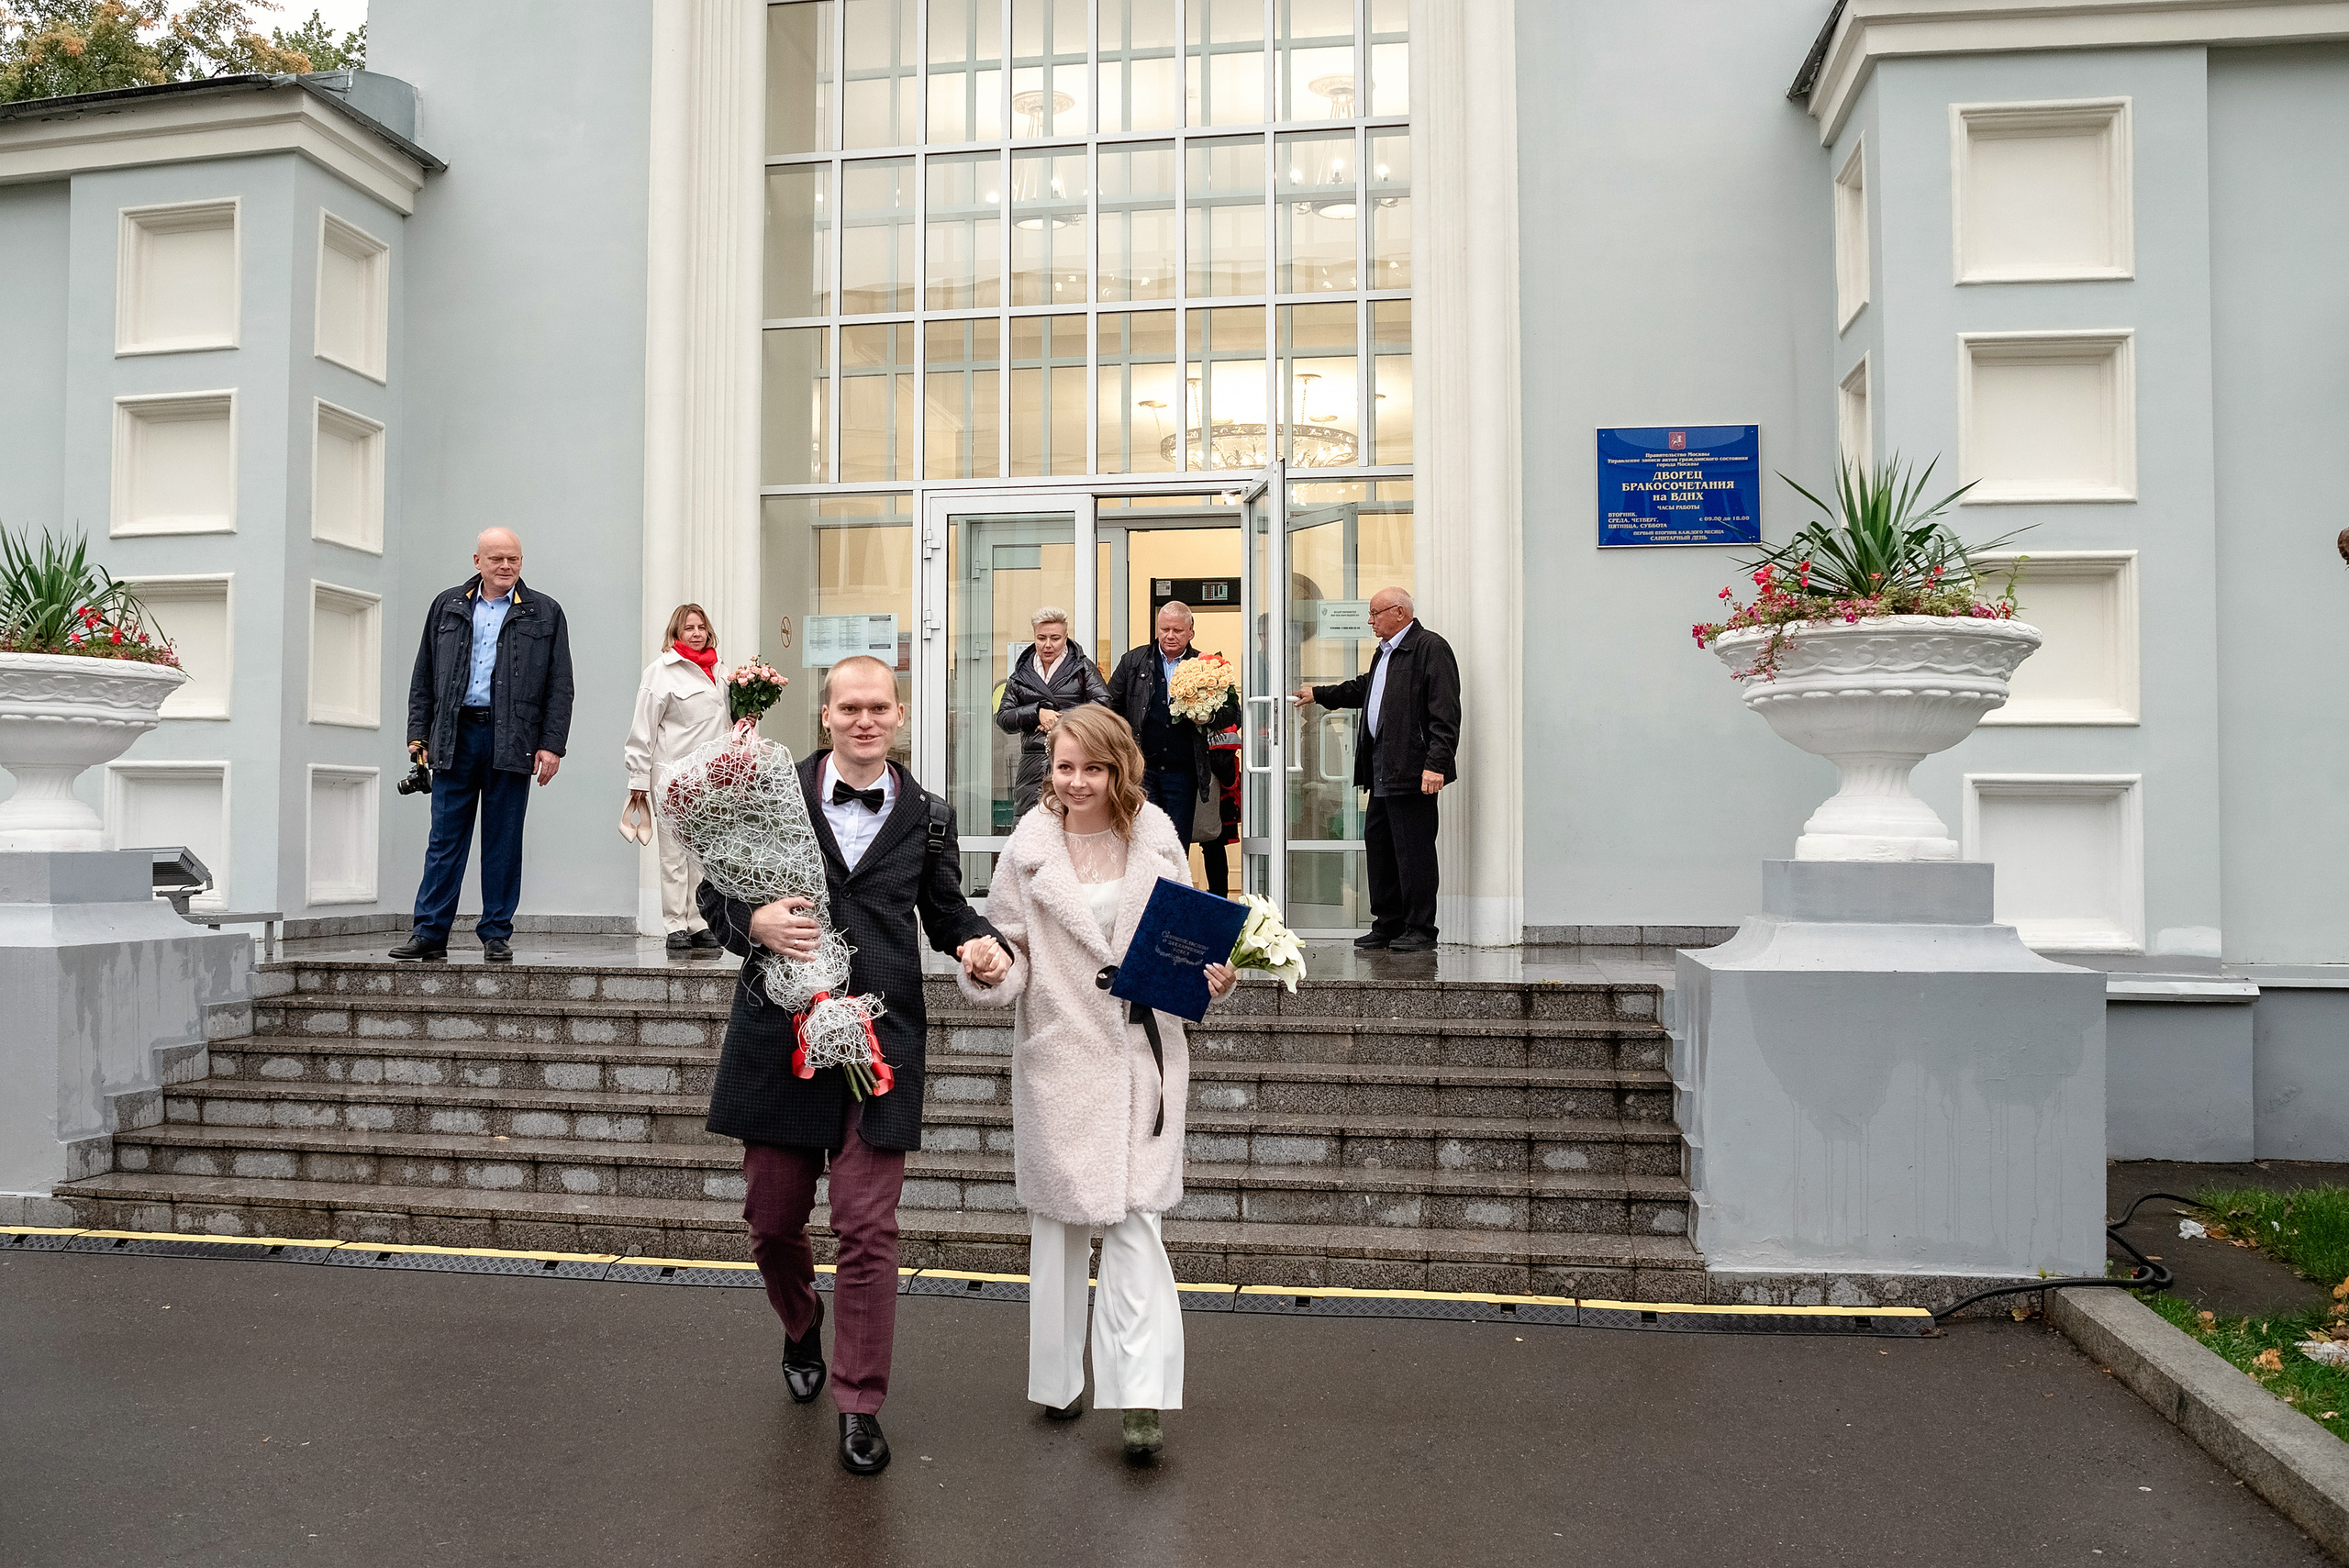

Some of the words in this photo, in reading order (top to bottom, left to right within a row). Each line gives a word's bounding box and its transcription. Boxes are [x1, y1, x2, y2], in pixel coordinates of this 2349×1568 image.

[1653, 471, 1702, 481] ДВОРЕЦ
[1622, 481, 1734, 491] БРАКОСОЧЕТАНИЯ
[1670, 492, 1704, 502] ВДНХ
